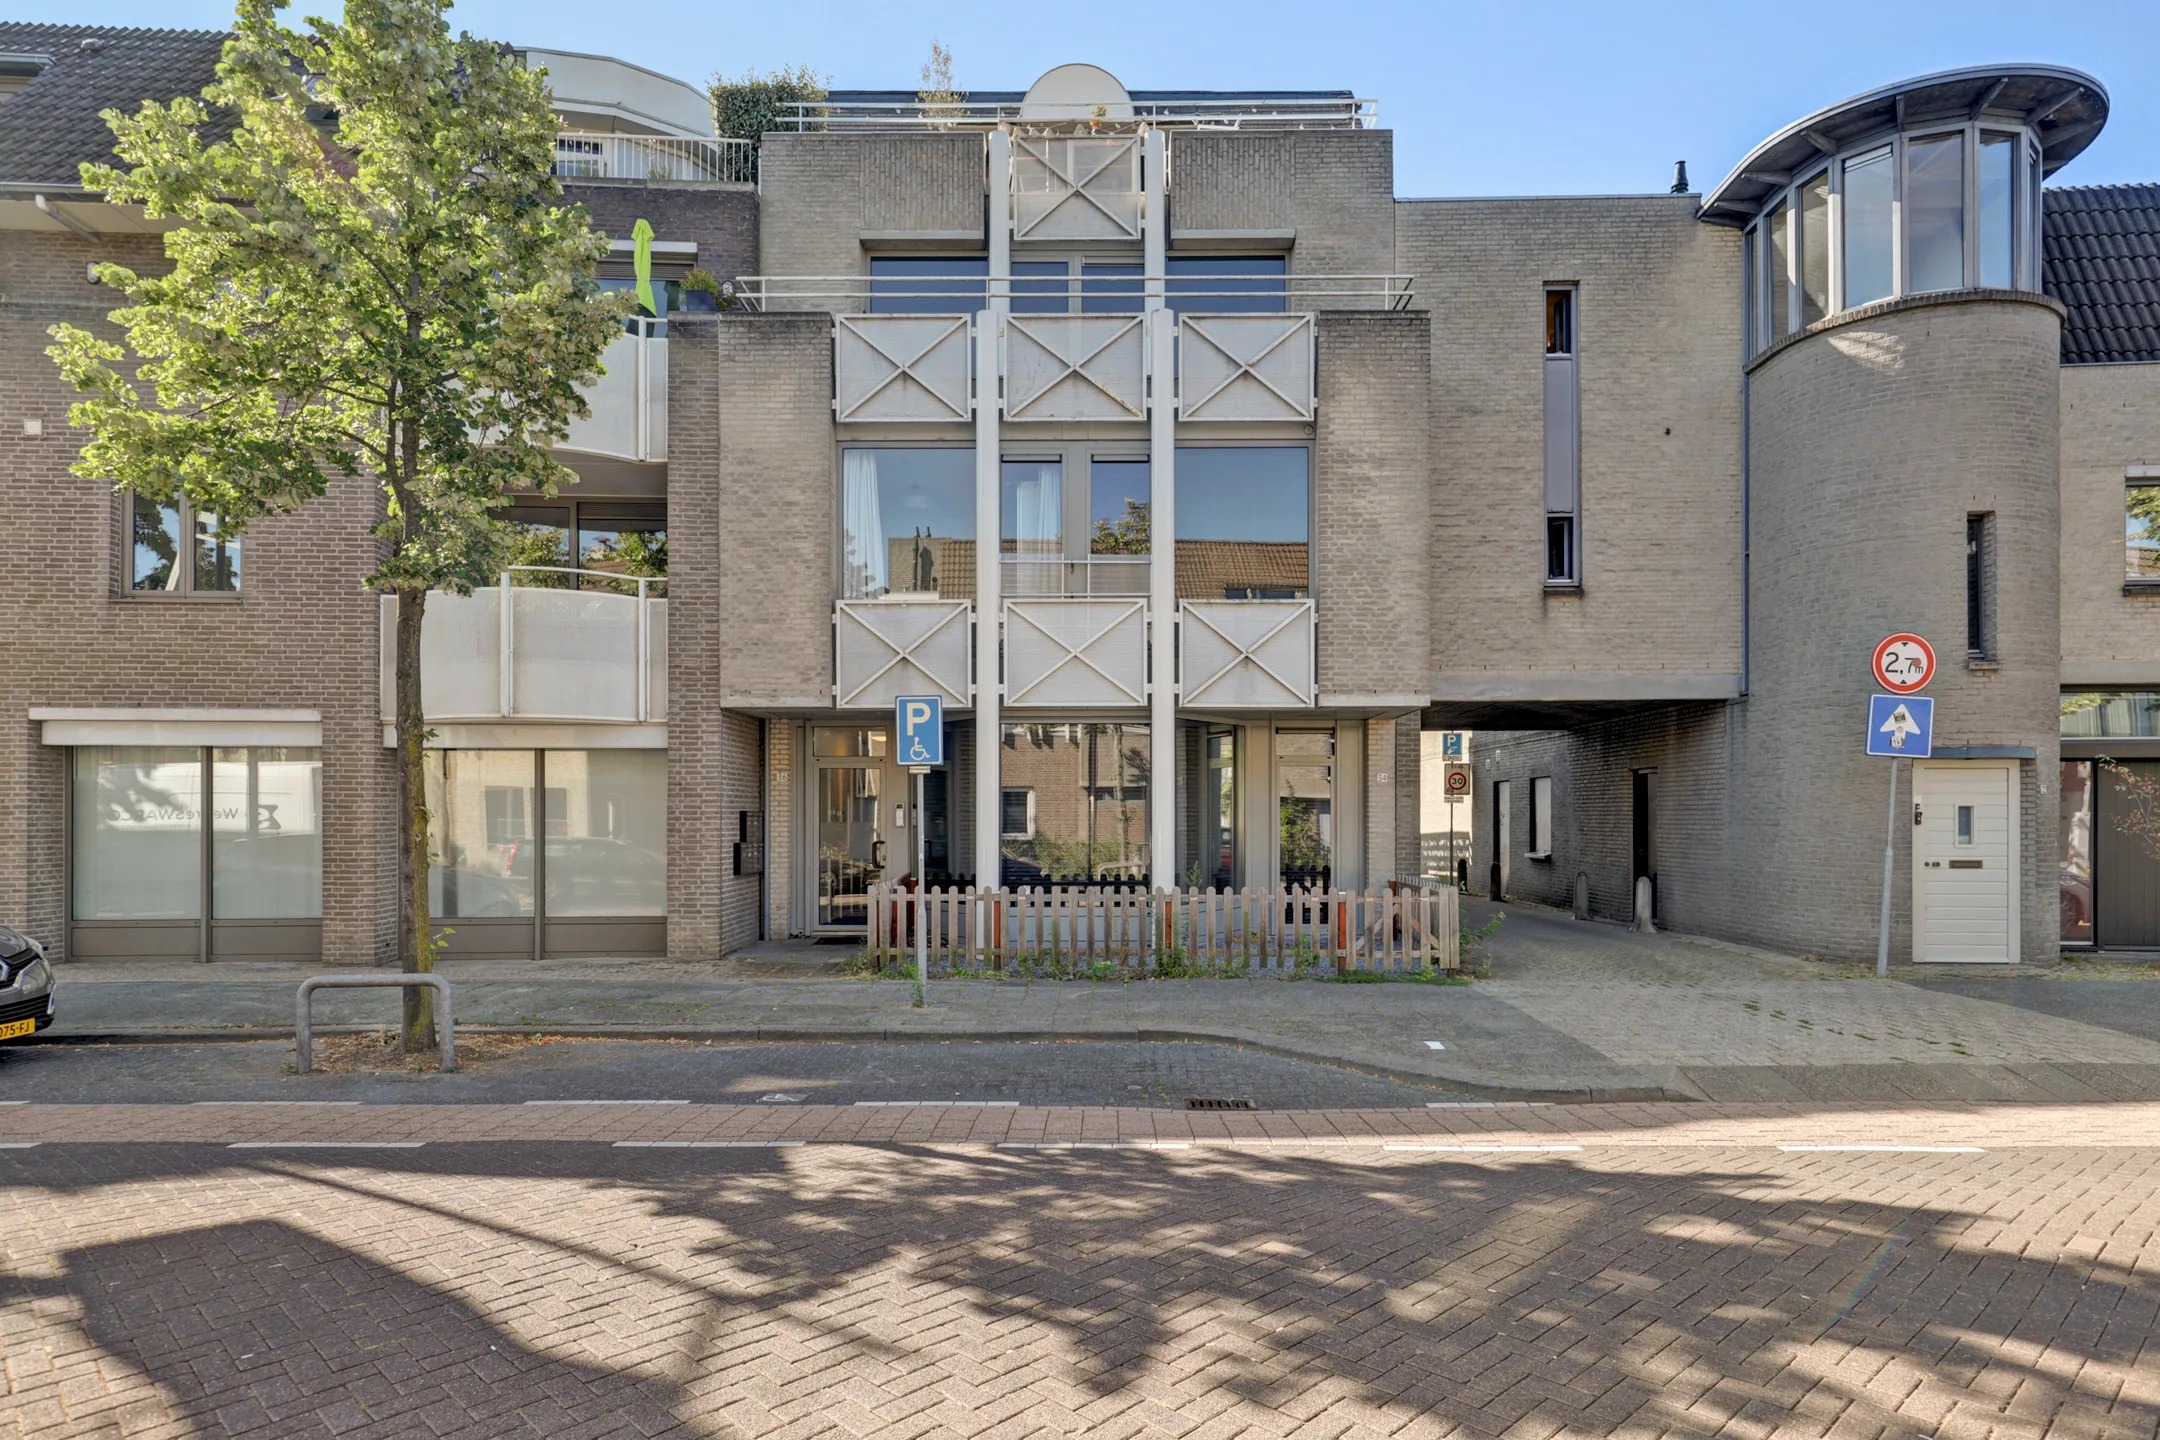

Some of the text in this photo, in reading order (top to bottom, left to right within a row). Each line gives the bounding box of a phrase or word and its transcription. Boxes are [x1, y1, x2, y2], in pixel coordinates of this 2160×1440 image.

[907, 703, 931, 736] P
[1447, 735, 1457, 747] P
[1451, 777, 1464, 785] 30
